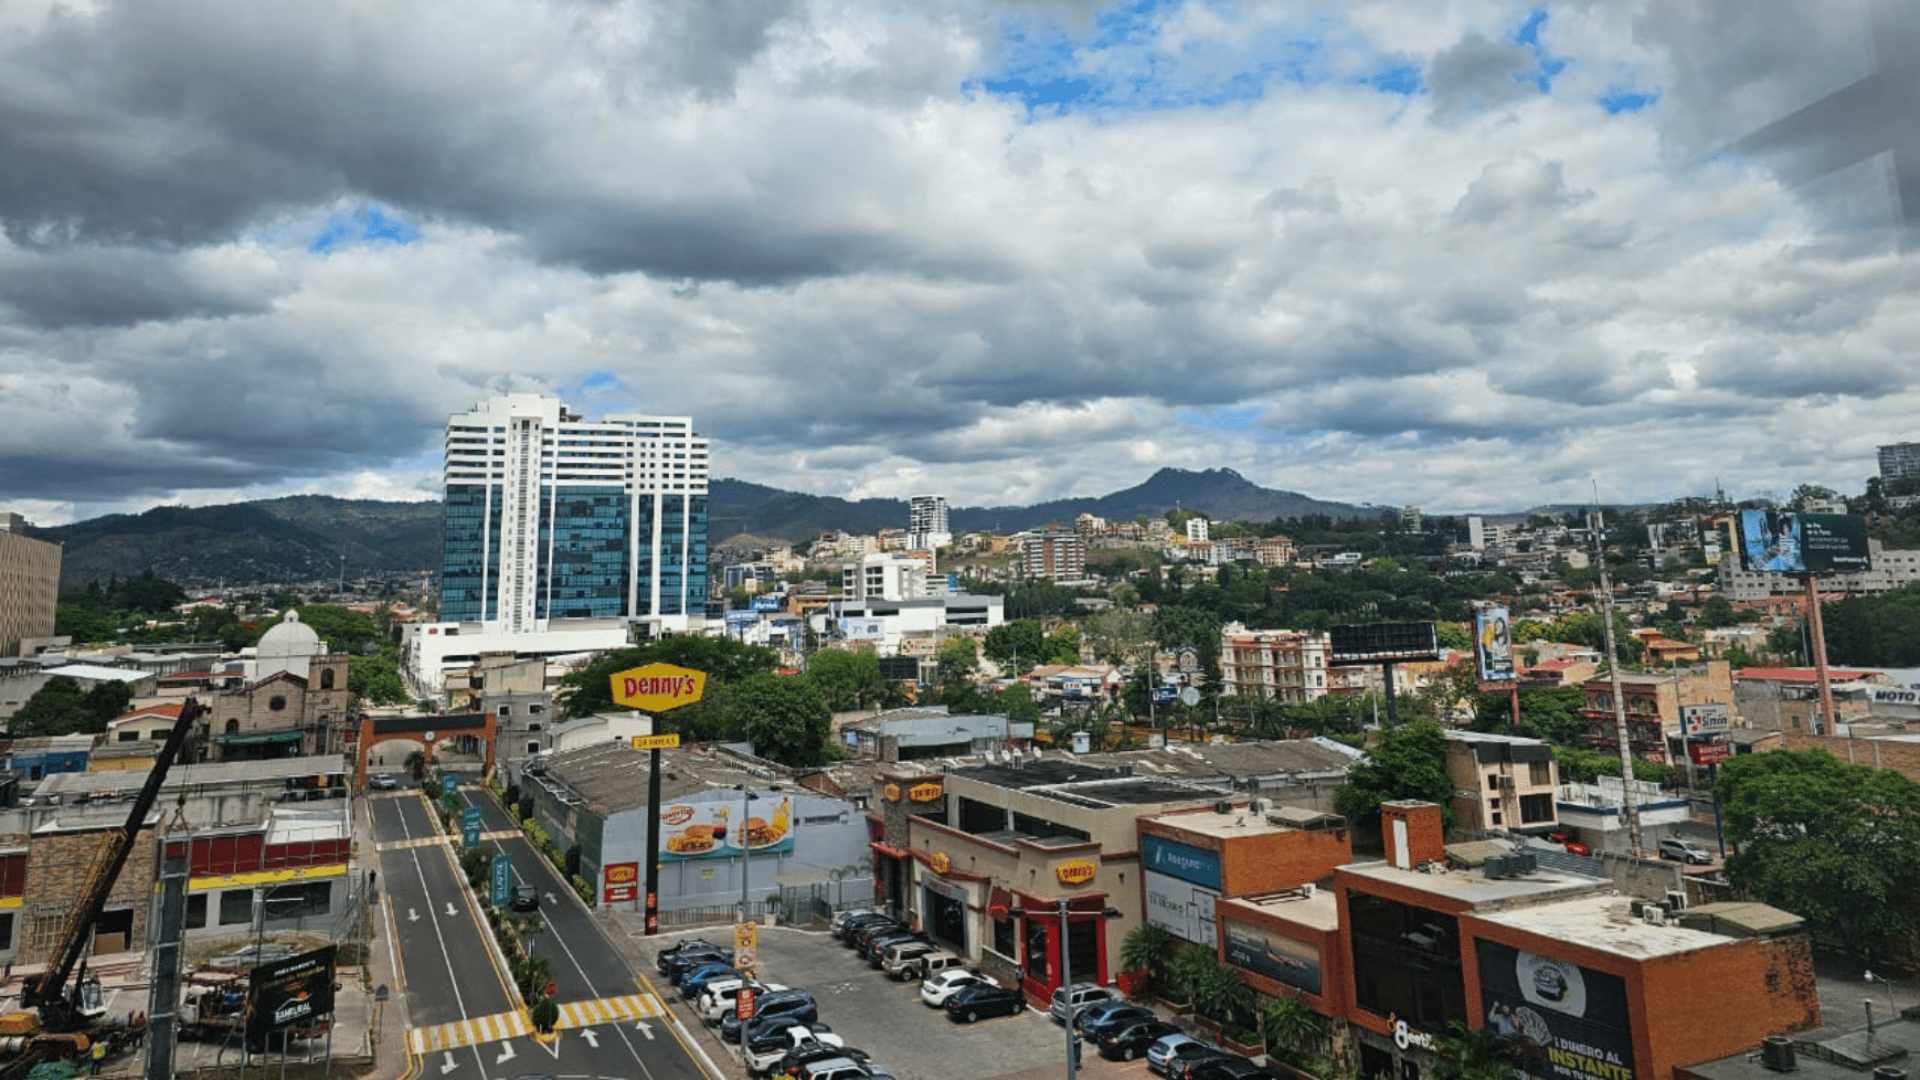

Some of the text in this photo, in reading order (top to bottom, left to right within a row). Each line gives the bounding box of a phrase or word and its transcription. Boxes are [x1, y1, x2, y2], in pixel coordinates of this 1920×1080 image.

[623, 674, 694, 698] Denny's
[1875, 691, 1915, 701] MOTO
[1548, 1047, 1632, 1080] INSTANTE
[1606, 1051, 1623, 1066] AL
